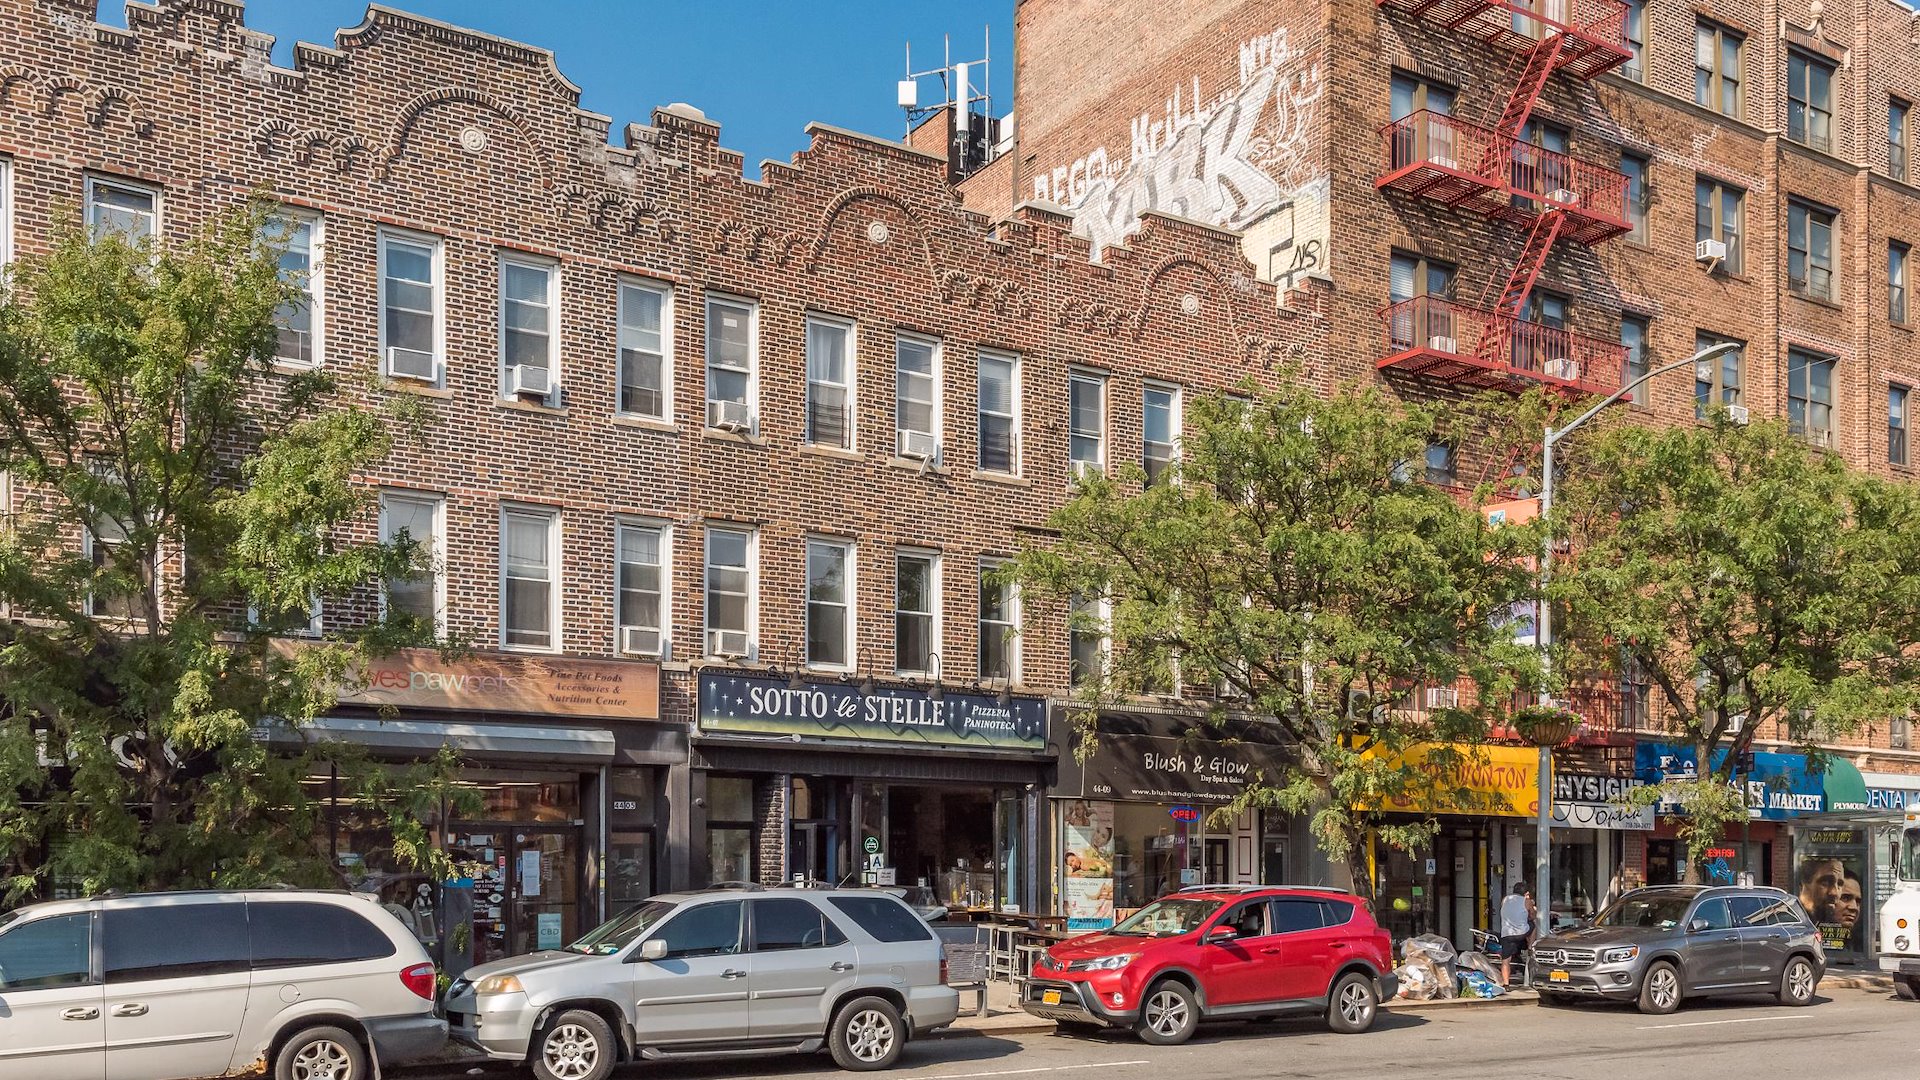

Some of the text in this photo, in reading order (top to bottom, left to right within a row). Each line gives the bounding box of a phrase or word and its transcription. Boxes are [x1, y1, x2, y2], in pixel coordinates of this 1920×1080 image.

[549, 668, 623, 682] Fine Pet Foods
[556, 683, 609, 692] Accessories
[547, 693, 627, 706] Nutrition Center
[750, 686, 945, 726] SOTTO le STELLE
[1143, 753, 1250, 775] Blush & Glow
[1200, 774, 1212, 783] Day
[1212, 776, 1223, 784] Spa
[1092, 785, 1112, 794] 44-09
[1131, 788, 1242, 800] www.blushandglowdayspa.c
[1768, 792, 1822, 811] MARKET
[1171, 810, 1197, 820] OPEN
[873, 856, 881, 867] A
[1427, 861, 1434, 870] A
[540, 928, 560, 936] CBD
